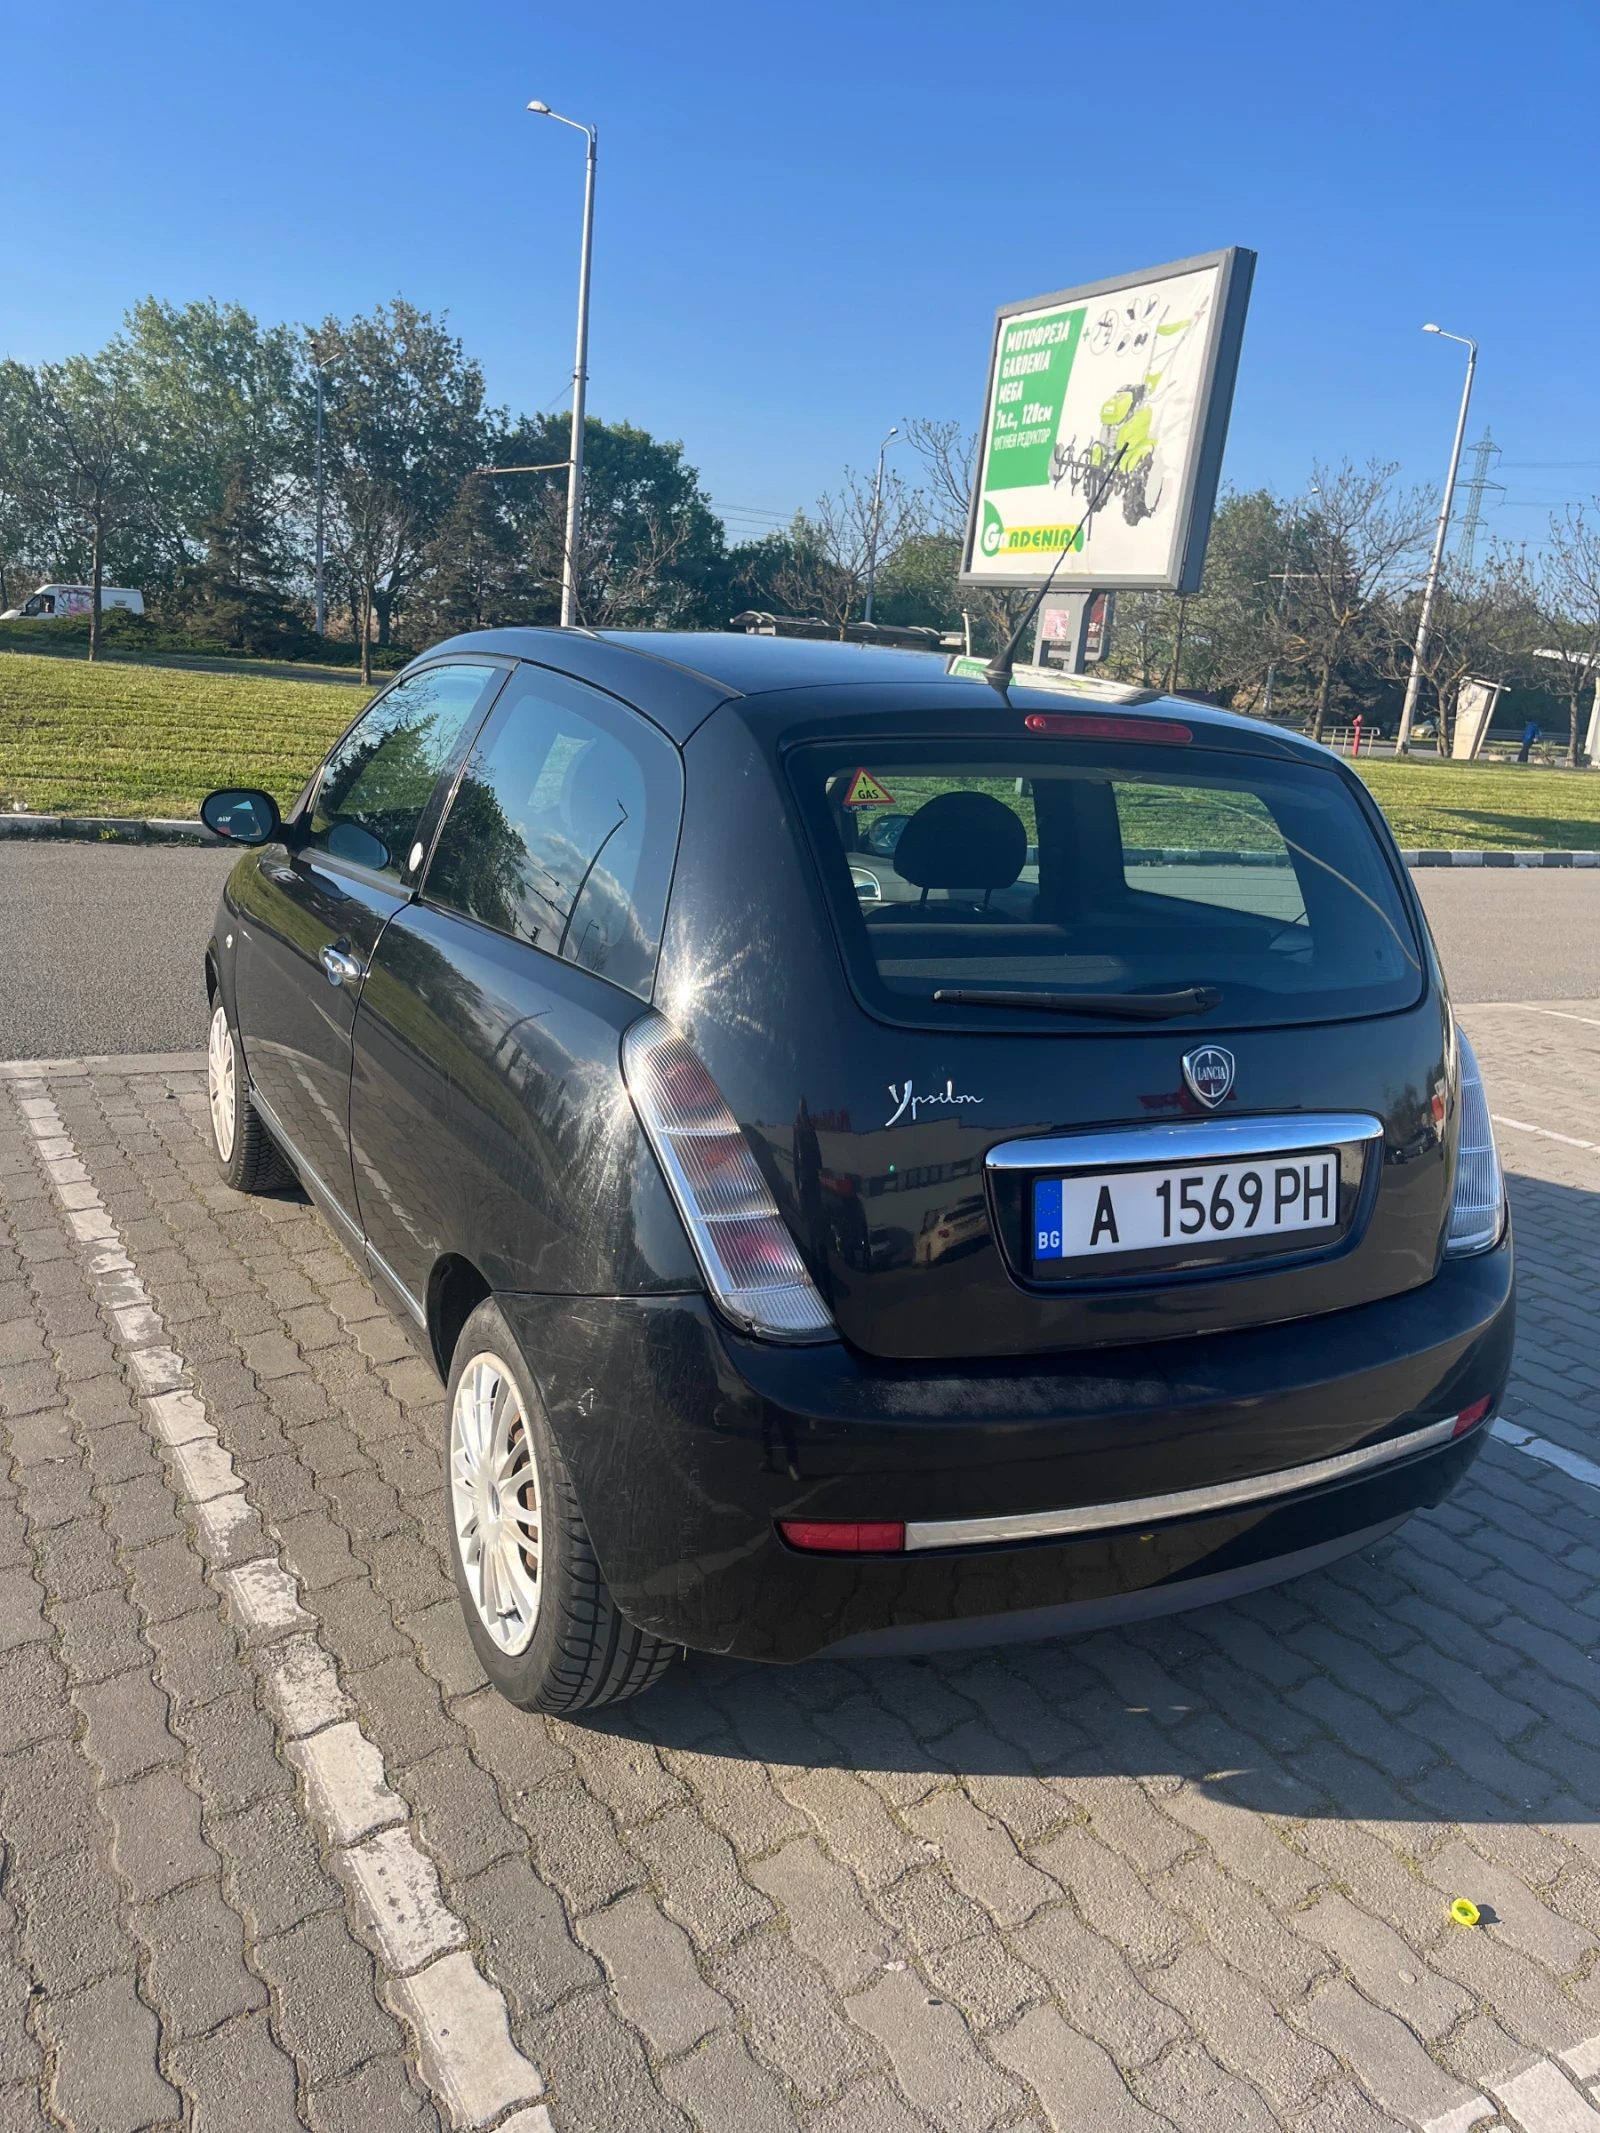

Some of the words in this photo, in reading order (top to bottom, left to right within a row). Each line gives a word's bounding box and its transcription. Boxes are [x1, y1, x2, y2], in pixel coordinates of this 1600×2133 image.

[1006, 320, 1070, 353] МОТОФРЕЗА
[1002, 349, 1052, 379] GARDENIA
[998, 380, 1024, 404] MEGA
[858, 790, 879, 799] GAS
[1197, 1066, 1226, 1080] LANCIA
[885, 1080, 984, 1126] Ypsilon
[1089, 1185, 1120, 1246] A
[1156, 1171, 1263, 1238] 1569
[1274, 1163, 1329, 1225] PH
[1038, 1230, 1060, 1250] BG
